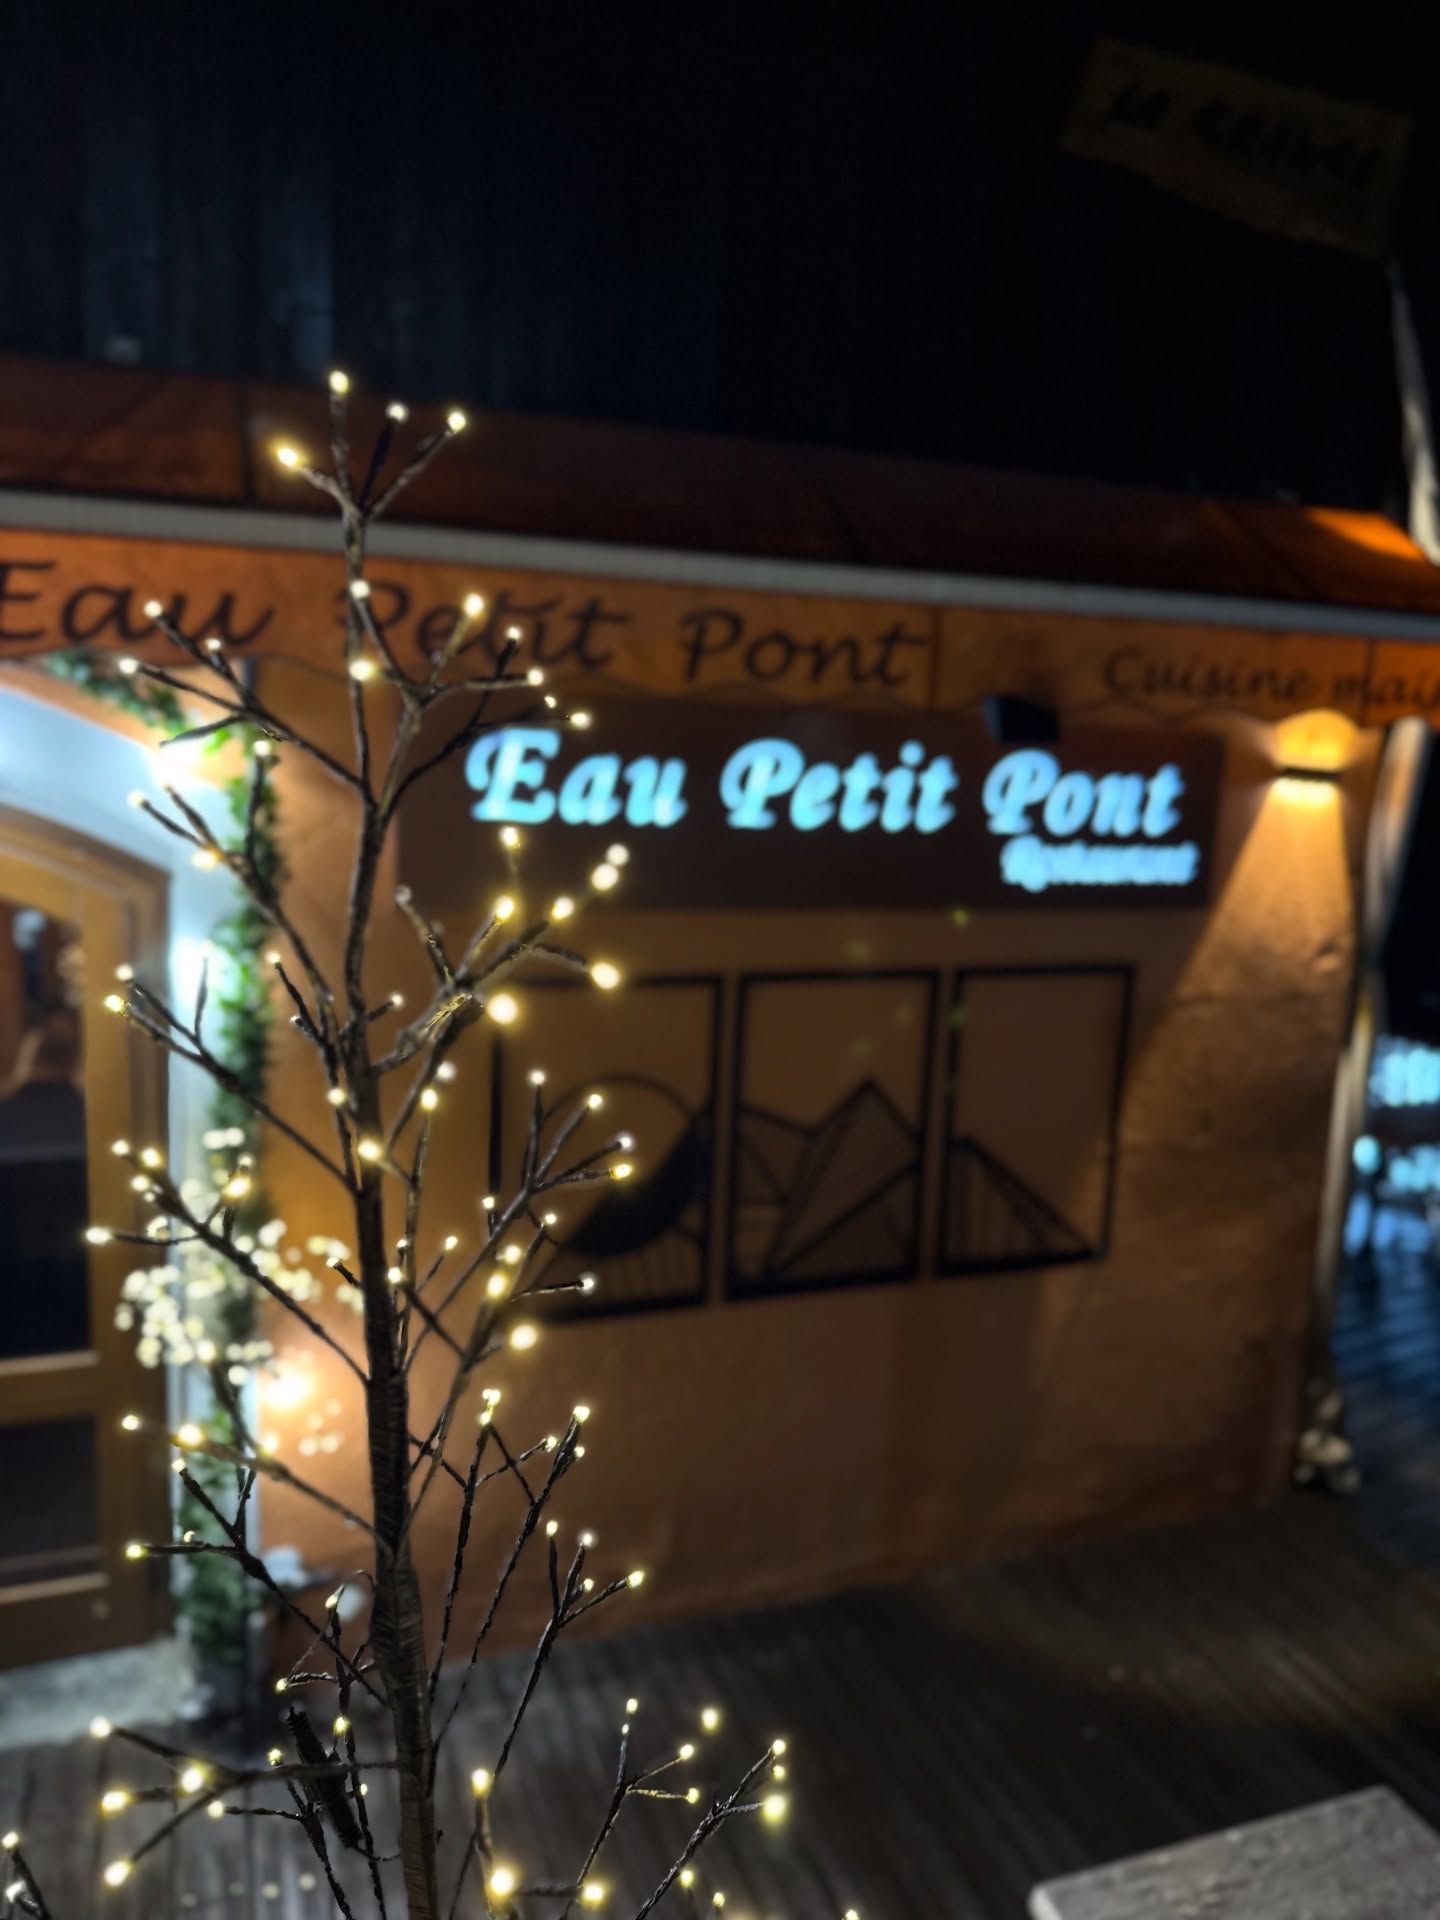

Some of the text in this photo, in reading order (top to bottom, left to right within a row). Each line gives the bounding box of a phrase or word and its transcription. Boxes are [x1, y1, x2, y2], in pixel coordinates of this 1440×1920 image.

[0, 559, 276, 647] Eau
[678, 607, 930, 688] Pont
[1104, 646, 1312, 700] Cuisine
[465, 727, 1184, 837] Eau Petit Pont
